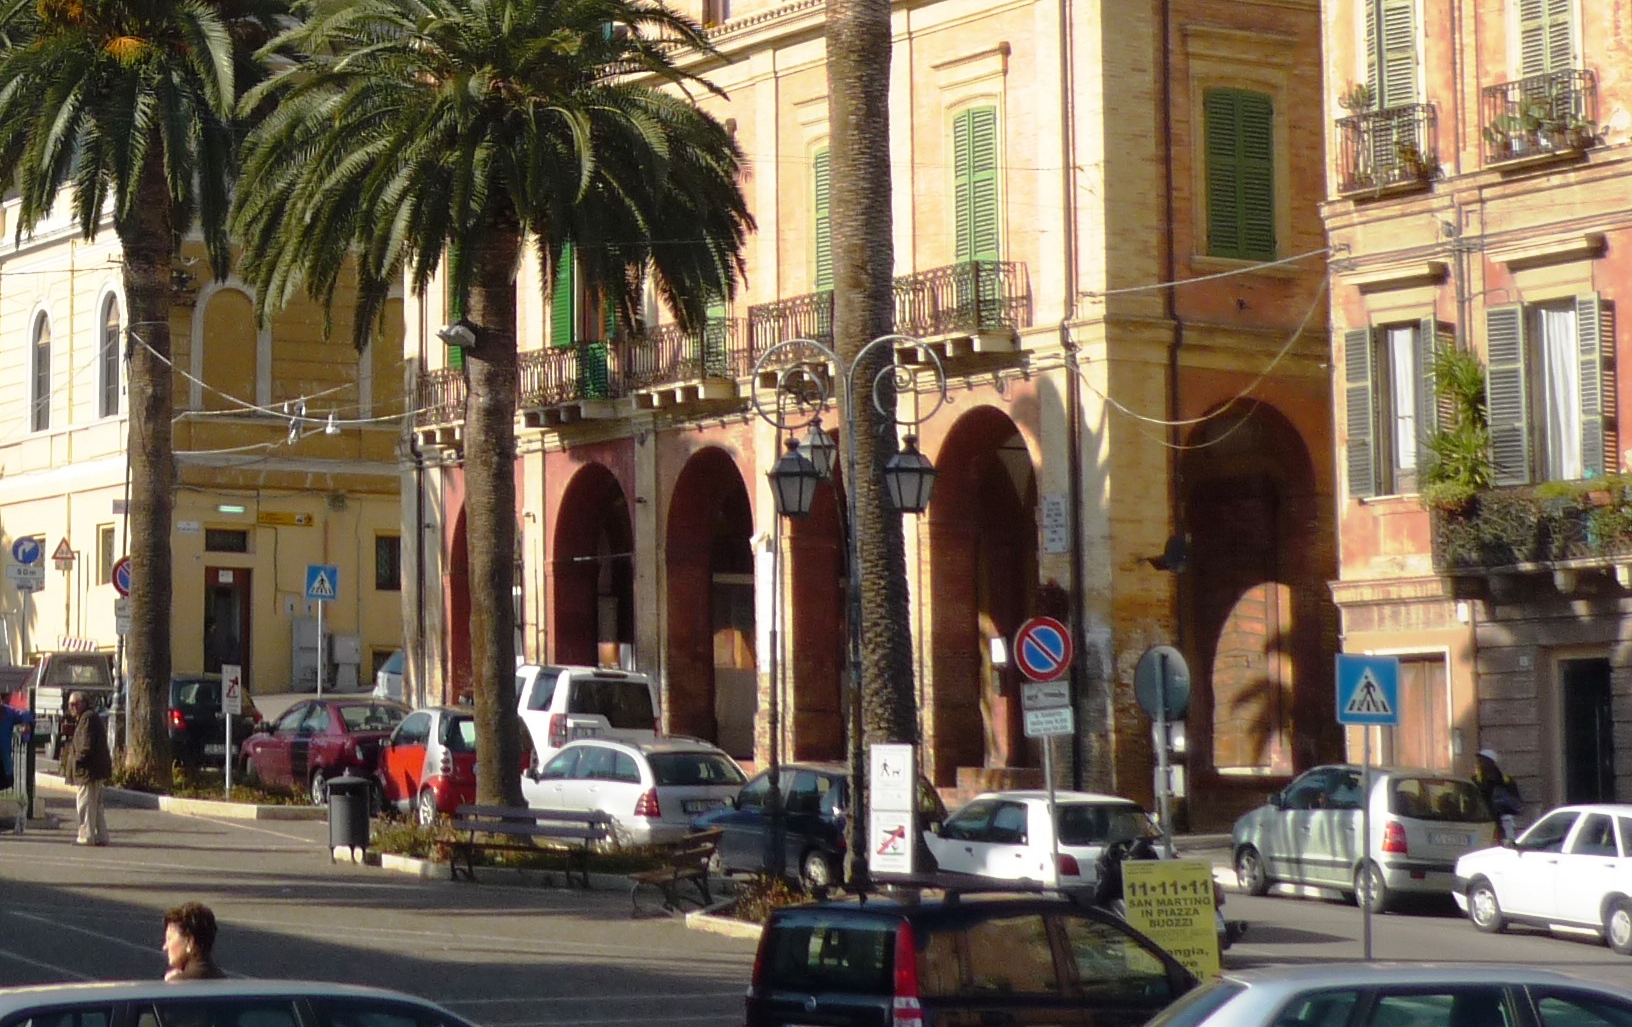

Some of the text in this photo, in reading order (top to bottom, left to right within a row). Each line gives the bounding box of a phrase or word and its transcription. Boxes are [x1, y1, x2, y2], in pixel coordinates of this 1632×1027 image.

[1129, 897, 1211, 908] SAN MARTINO
[1141, 908, 1200, 918] IN PIAZZA
[1149, 918, 1193, 928] BUOZZI
